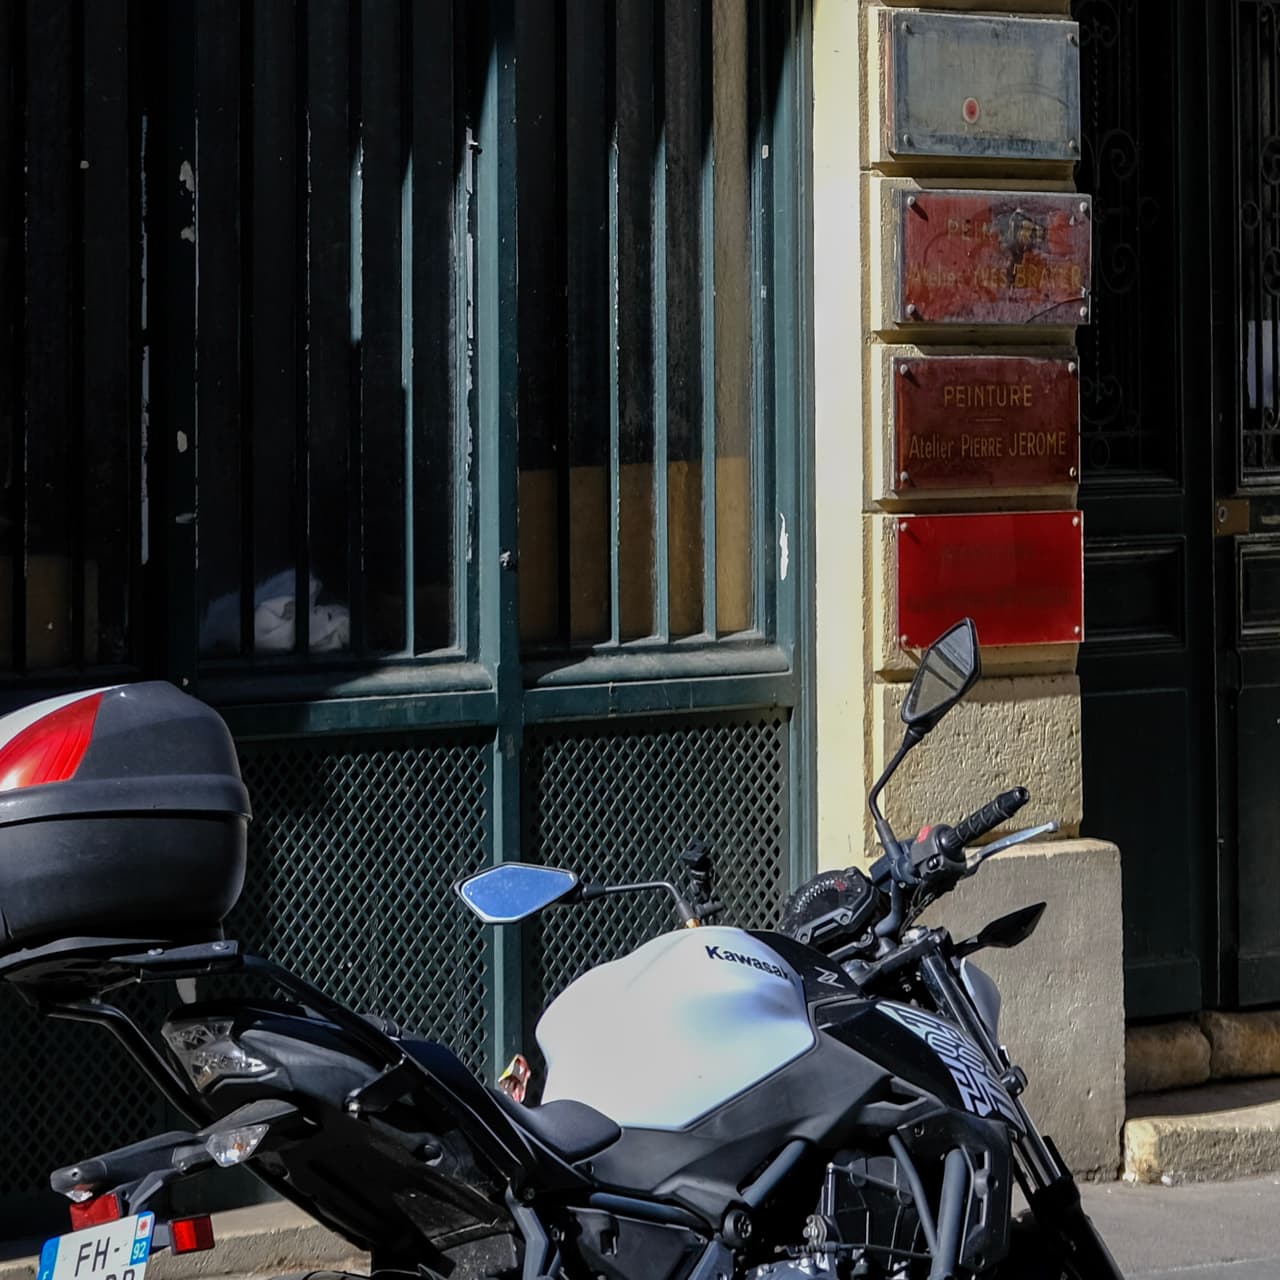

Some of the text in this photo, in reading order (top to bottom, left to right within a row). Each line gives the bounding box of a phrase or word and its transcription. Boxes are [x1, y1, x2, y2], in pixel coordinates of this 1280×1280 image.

[943, 384, 1033, 408] PEINTURE
[908, 434, 955, 459] Atelier
[132, 1241, 147, 1260] 92
